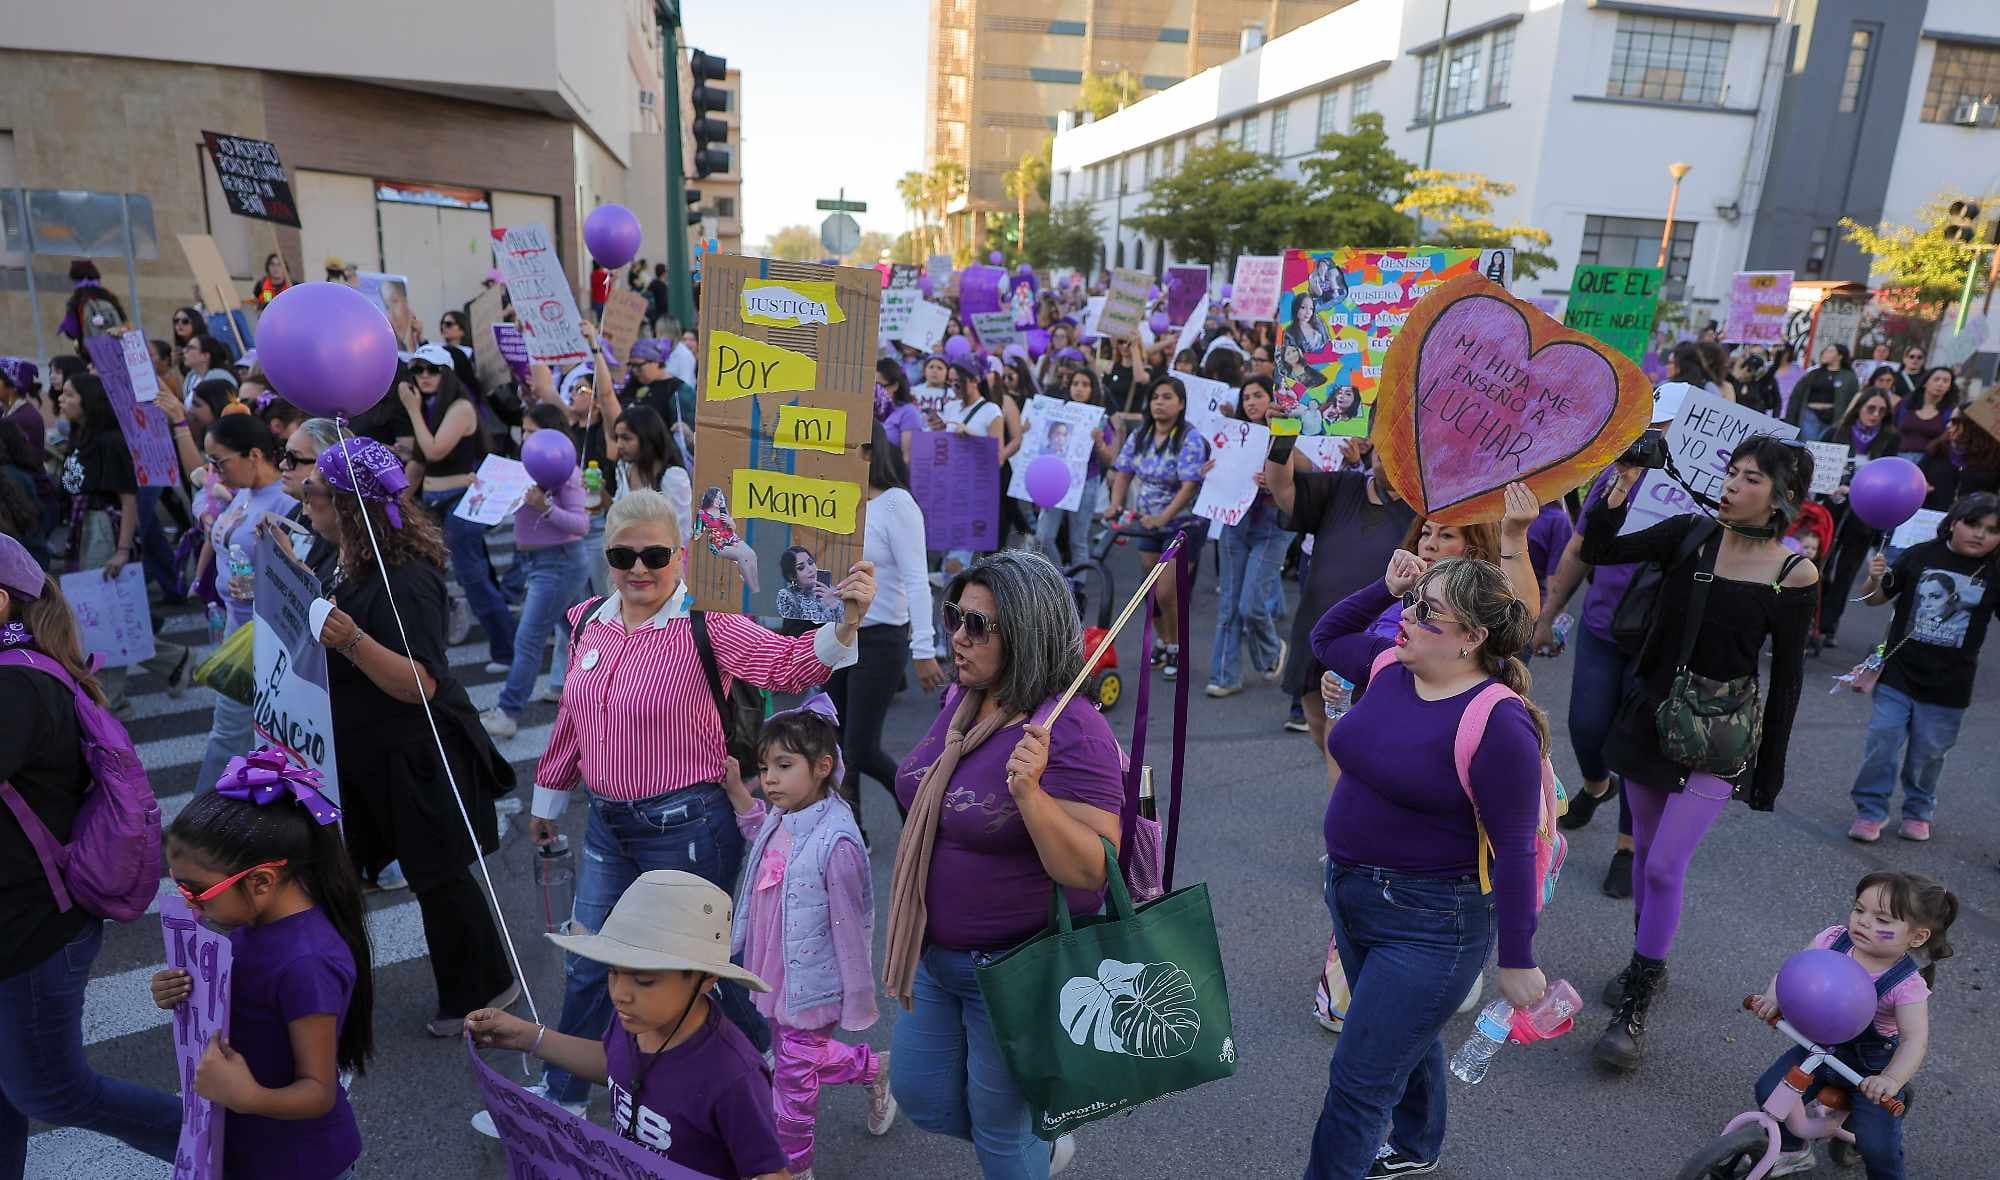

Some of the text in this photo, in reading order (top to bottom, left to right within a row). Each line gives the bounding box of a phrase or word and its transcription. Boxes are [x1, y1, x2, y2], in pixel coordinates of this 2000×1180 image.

[1381, 258, 1429, 268] DENISSE
[1350, 291, 1398, 302] QUISIERA
[1578, 271, 1653, 295] QUE EL
[748, 297, 827, 316] JUSTICIA
[1330, 314, 1346, 323] DE
[716, 345, 780, 390] Por
[1455, 335, 1573, 414] MI HIJA ME
[1451, 364, 1545, 426] ENSEÑO A
[1421, 377, 1534, 472] LUCHAR
[1679, 433, 1707, 460] YO
[1689, 465, 1724, 498] TE
[748, 481, 837, 519] Mamá
